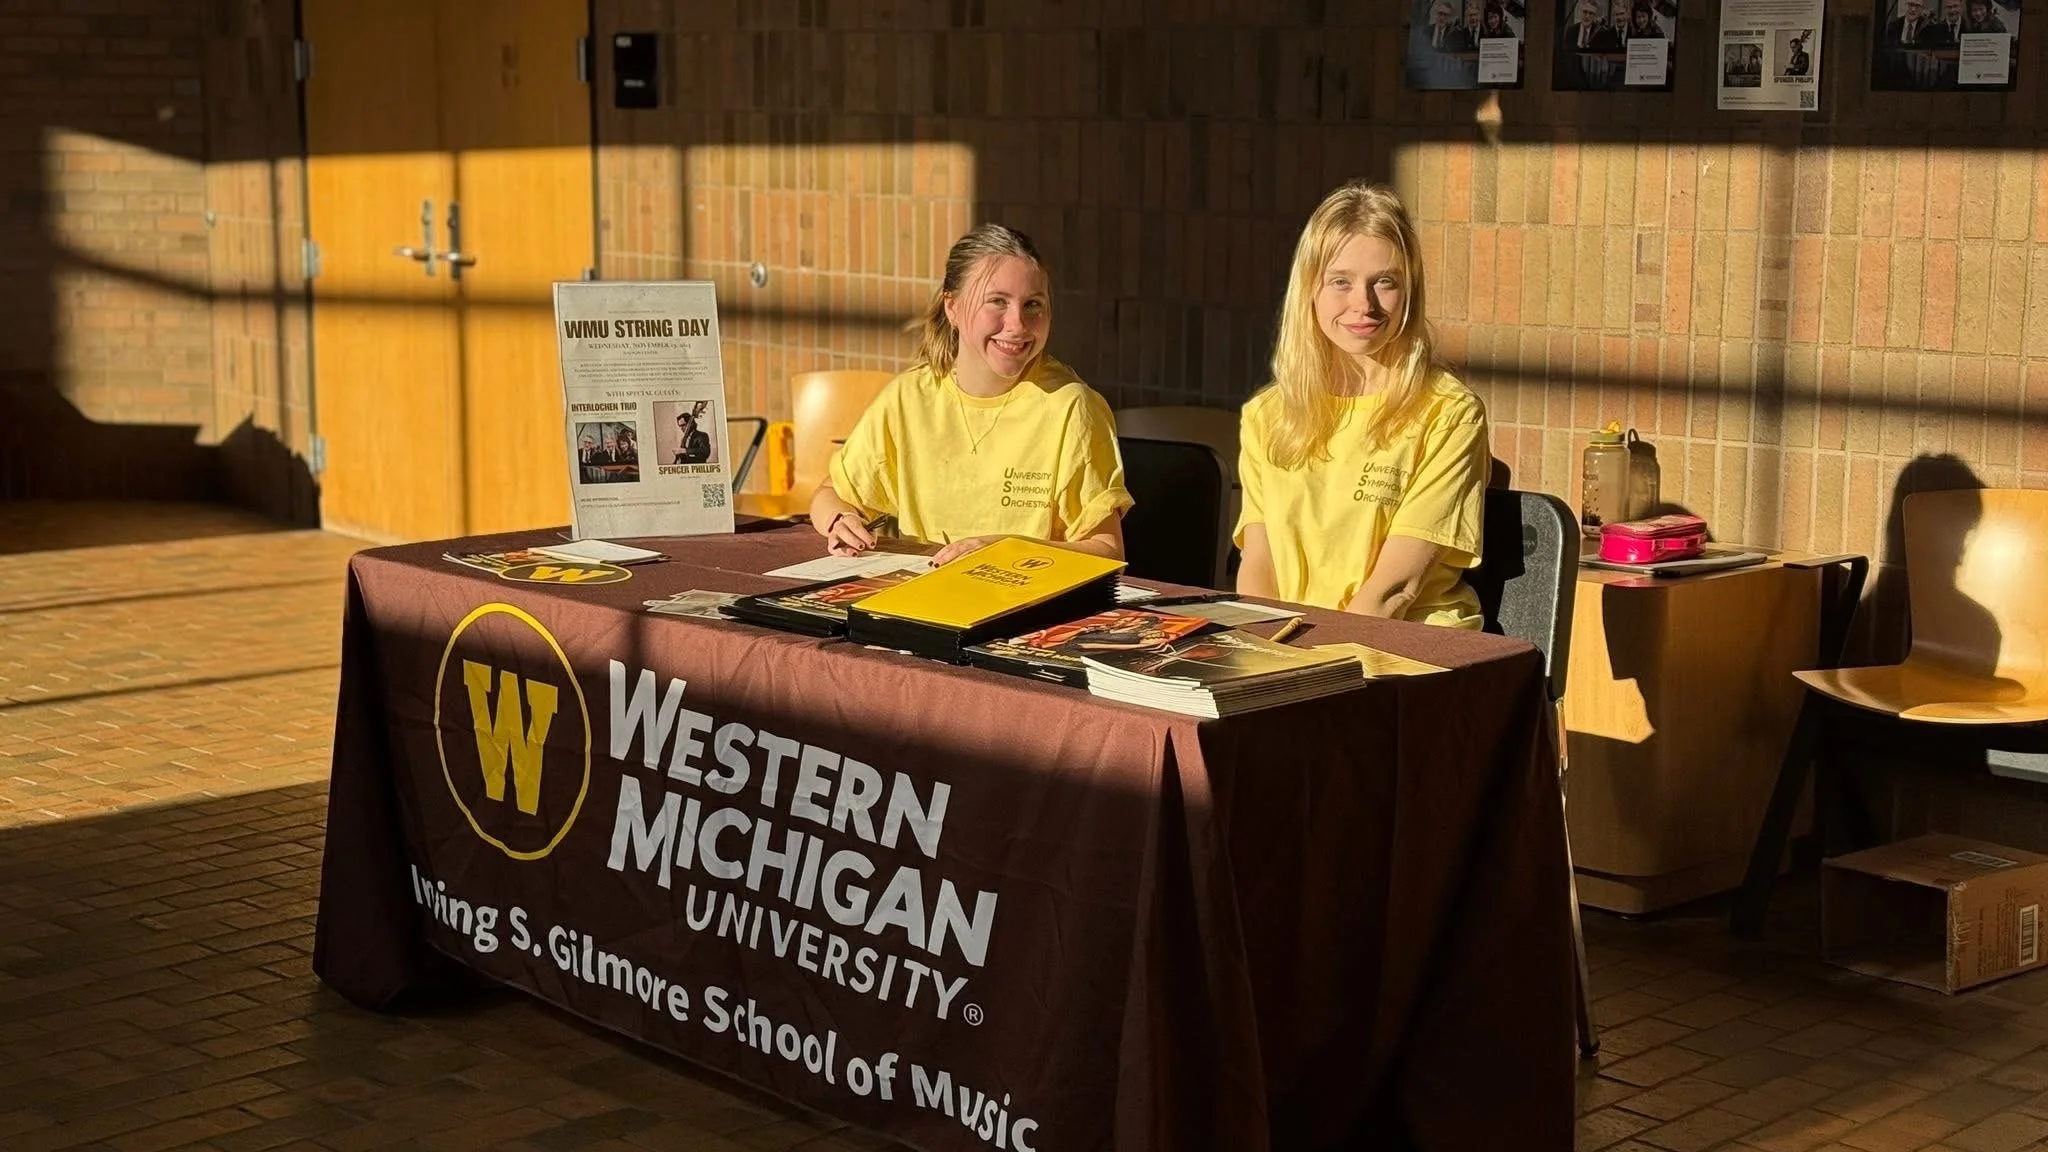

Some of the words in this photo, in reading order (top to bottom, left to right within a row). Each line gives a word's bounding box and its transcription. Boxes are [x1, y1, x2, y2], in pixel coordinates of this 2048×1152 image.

[564, 320, 609, 338] WMU
[615, 319, 672, 337] STRING
[679, 318, 710, 336] DAY
[571, 403, 618, 412] INTERLOCHEN
[620, 402, 637, 411] TRIO
[658, 466, 690, 475] SPENCER
[691, 464, 721, 474] PHILLIPS
[1004, 467, 1051, 480] UNIVERSITY
[1003, 481, 1051, 495] SYMPHONY
[1001, 496, 1051, 509] ORCHESTRA
[529, 566, 616, 582] W
[976, 563, 1033, 580] WESTERN
[463, 659, 558, 816] W
[609, 658, 951, 859] WESTERN
[607, 775, 998, 968] MICHIGAN
[686, 885, 969, 1021] UNIVERSITY
[411, 864, 498, 954] Irving
[511, 905, 542, 957] S.
[548, 925, 690, 1022] Gilmore
[703, 986, 837, 1085] School
[847, 1053, 899, 1100] of
[911, 1064, 1040, 1152] Music
